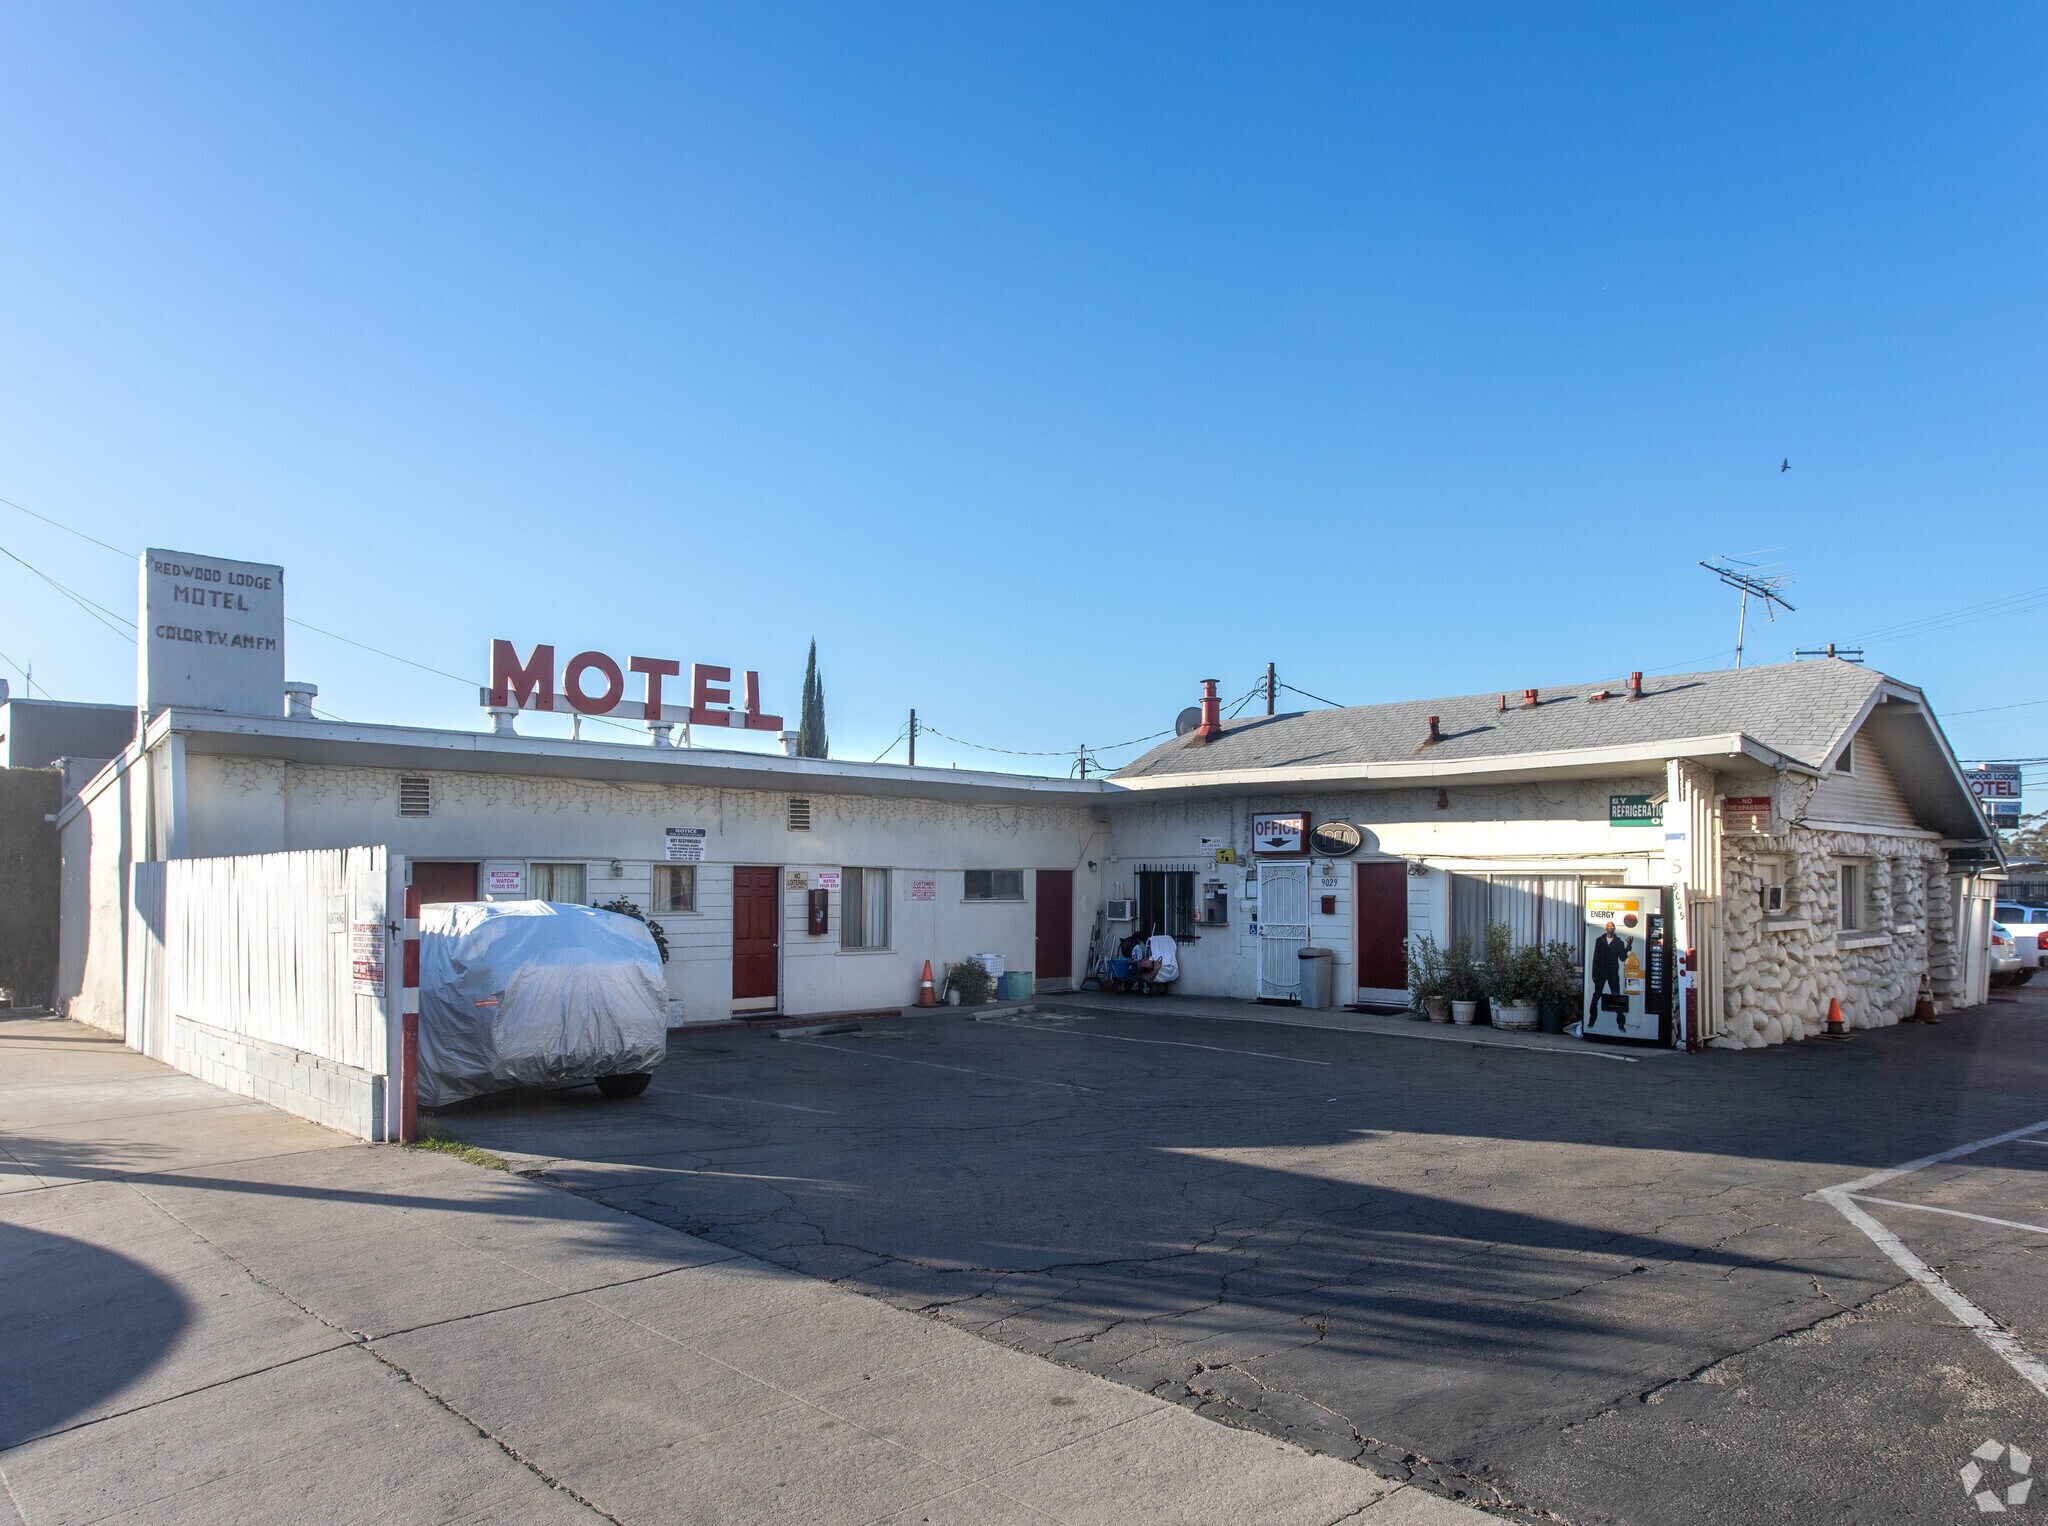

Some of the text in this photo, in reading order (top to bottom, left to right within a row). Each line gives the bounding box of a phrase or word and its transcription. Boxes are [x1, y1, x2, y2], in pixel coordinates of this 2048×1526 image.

[154, 561, 272, 590] REDWOOD LODGE
[173, 583, 250, 612] MOTEL
[490, 638, 783, 731] MOTEL
[1971, 781, 2018, 796] OTEL
[1612, 804, 1663, 817] REFRIGERATIO
[1256, 819, 1300, 836] OFFICE
[1316, 830, 1355, 848] OPEN
[1322, 878, 1338, 887] 9029
